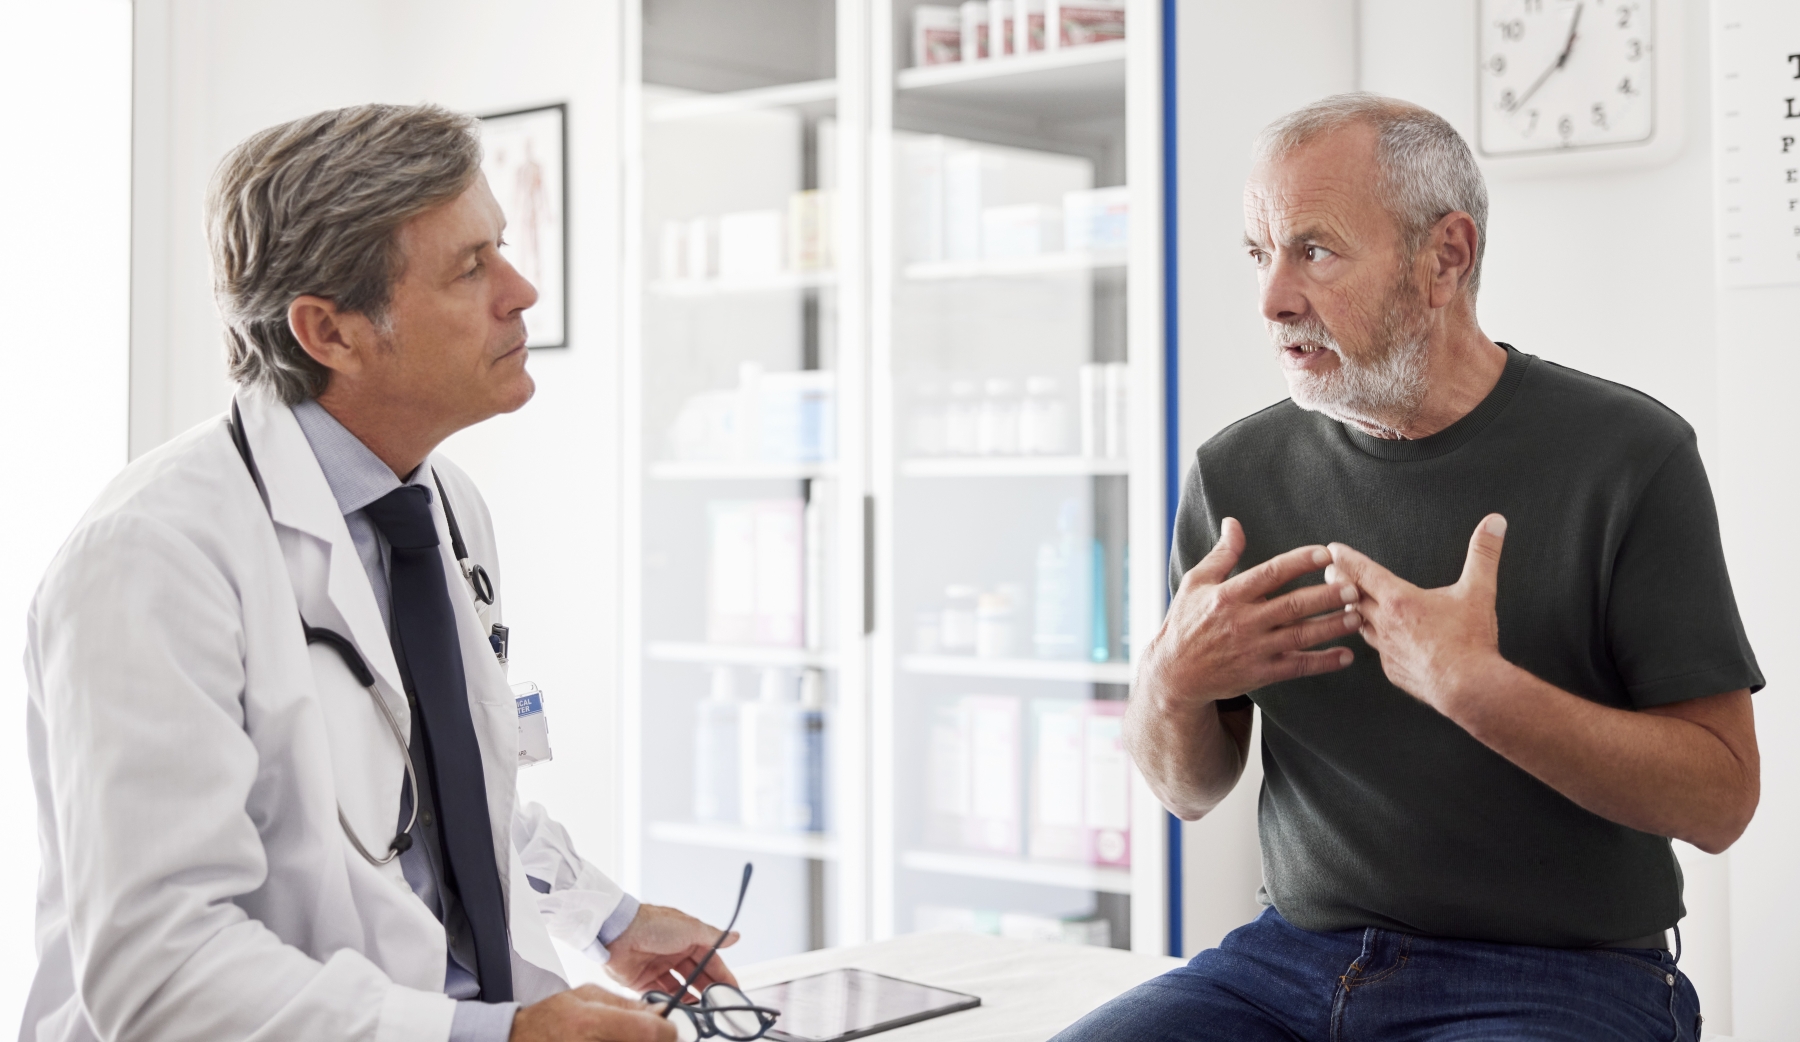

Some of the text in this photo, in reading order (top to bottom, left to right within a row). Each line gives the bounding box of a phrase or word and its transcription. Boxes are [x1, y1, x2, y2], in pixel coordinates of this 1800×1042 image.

[1616, 6, 1631, 29] 2
[1498, 18, 1525, 42] 10
[1626, 38, 1642, 62] 3
[1490, 53, 1507, 76] 9
[1617, 76, 1632, 96] 4
[1527, 109, 1540, 131] 7
[1591, 102, 1607, 126] 5
[1783, 98, 1800, 119] L
[1558, 114, 1574, 138] 6
[1781, 136, 1795, 153] P
